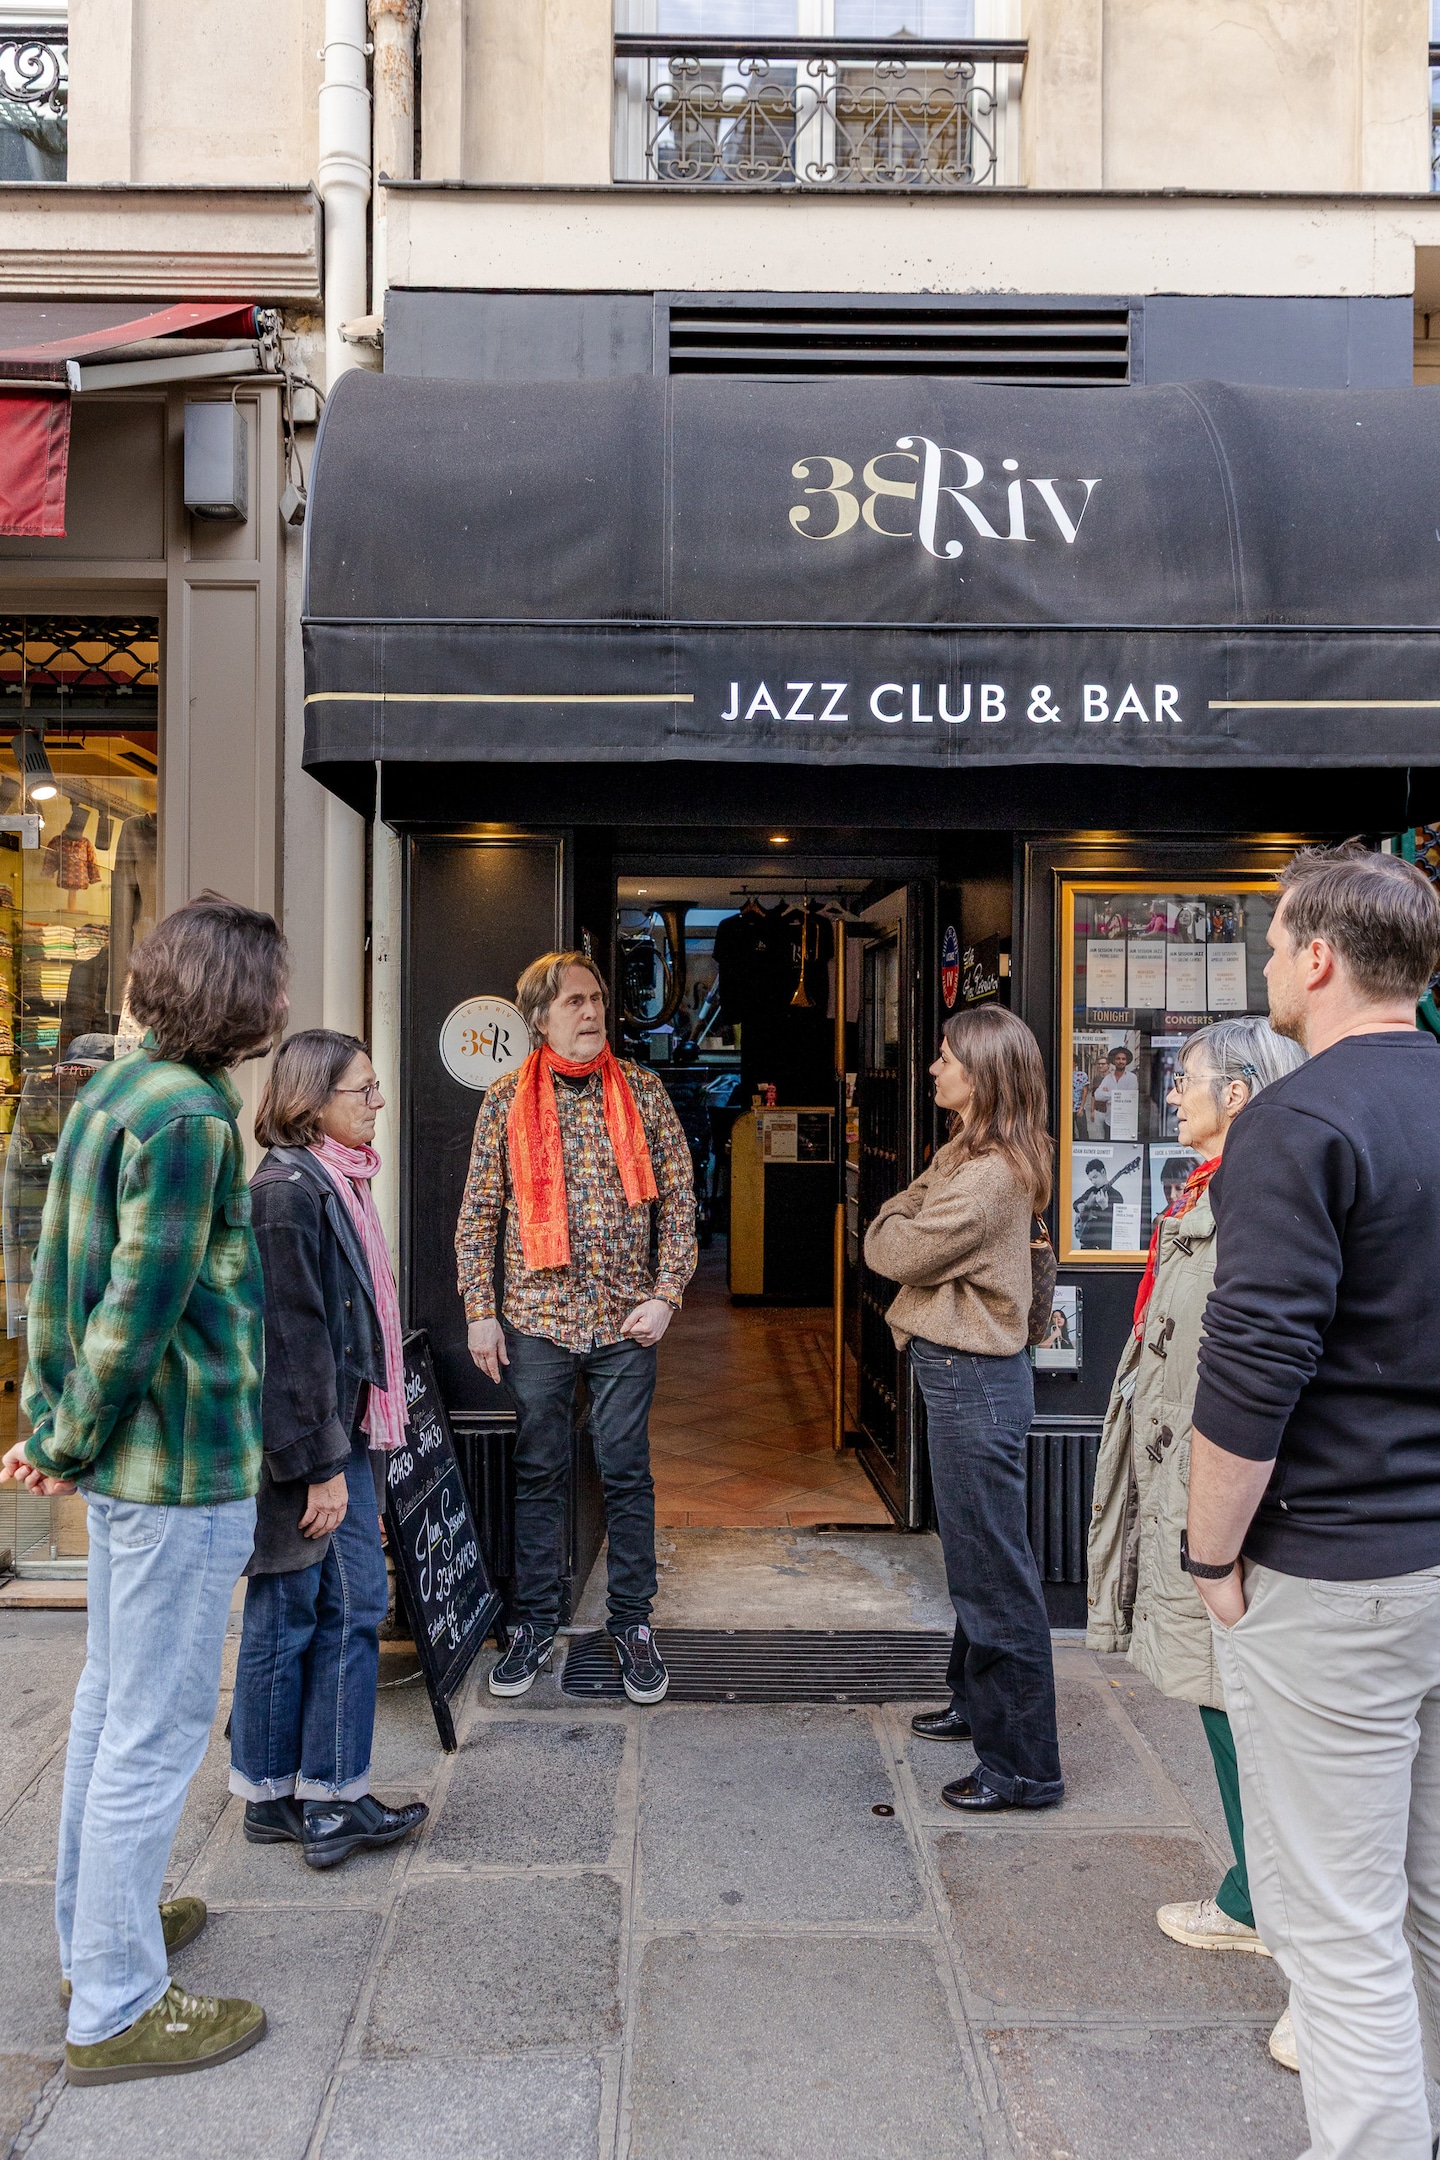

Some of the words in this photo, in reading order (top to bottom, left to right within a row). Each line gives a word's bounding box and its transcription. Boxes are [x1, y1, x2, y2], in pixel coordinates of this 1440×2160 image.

[720, 681, 849, 722] JAZZ
[869, 683, 1007, 724] CLUB
[1026, 684, 1062, 724] &
[1082, 682, 1183, 723] BAR
[461, 1009, 472, 1019] LE
[495, 1006, 512, 1018] RIV
[1092, 1010, 1129, 1023] TONIGHT
[1165, 1015, 1213, 1025] CONCERTS
[387, 1452, 414, 1489] 19H30
[415, 1507, 443, 1603] Jam
